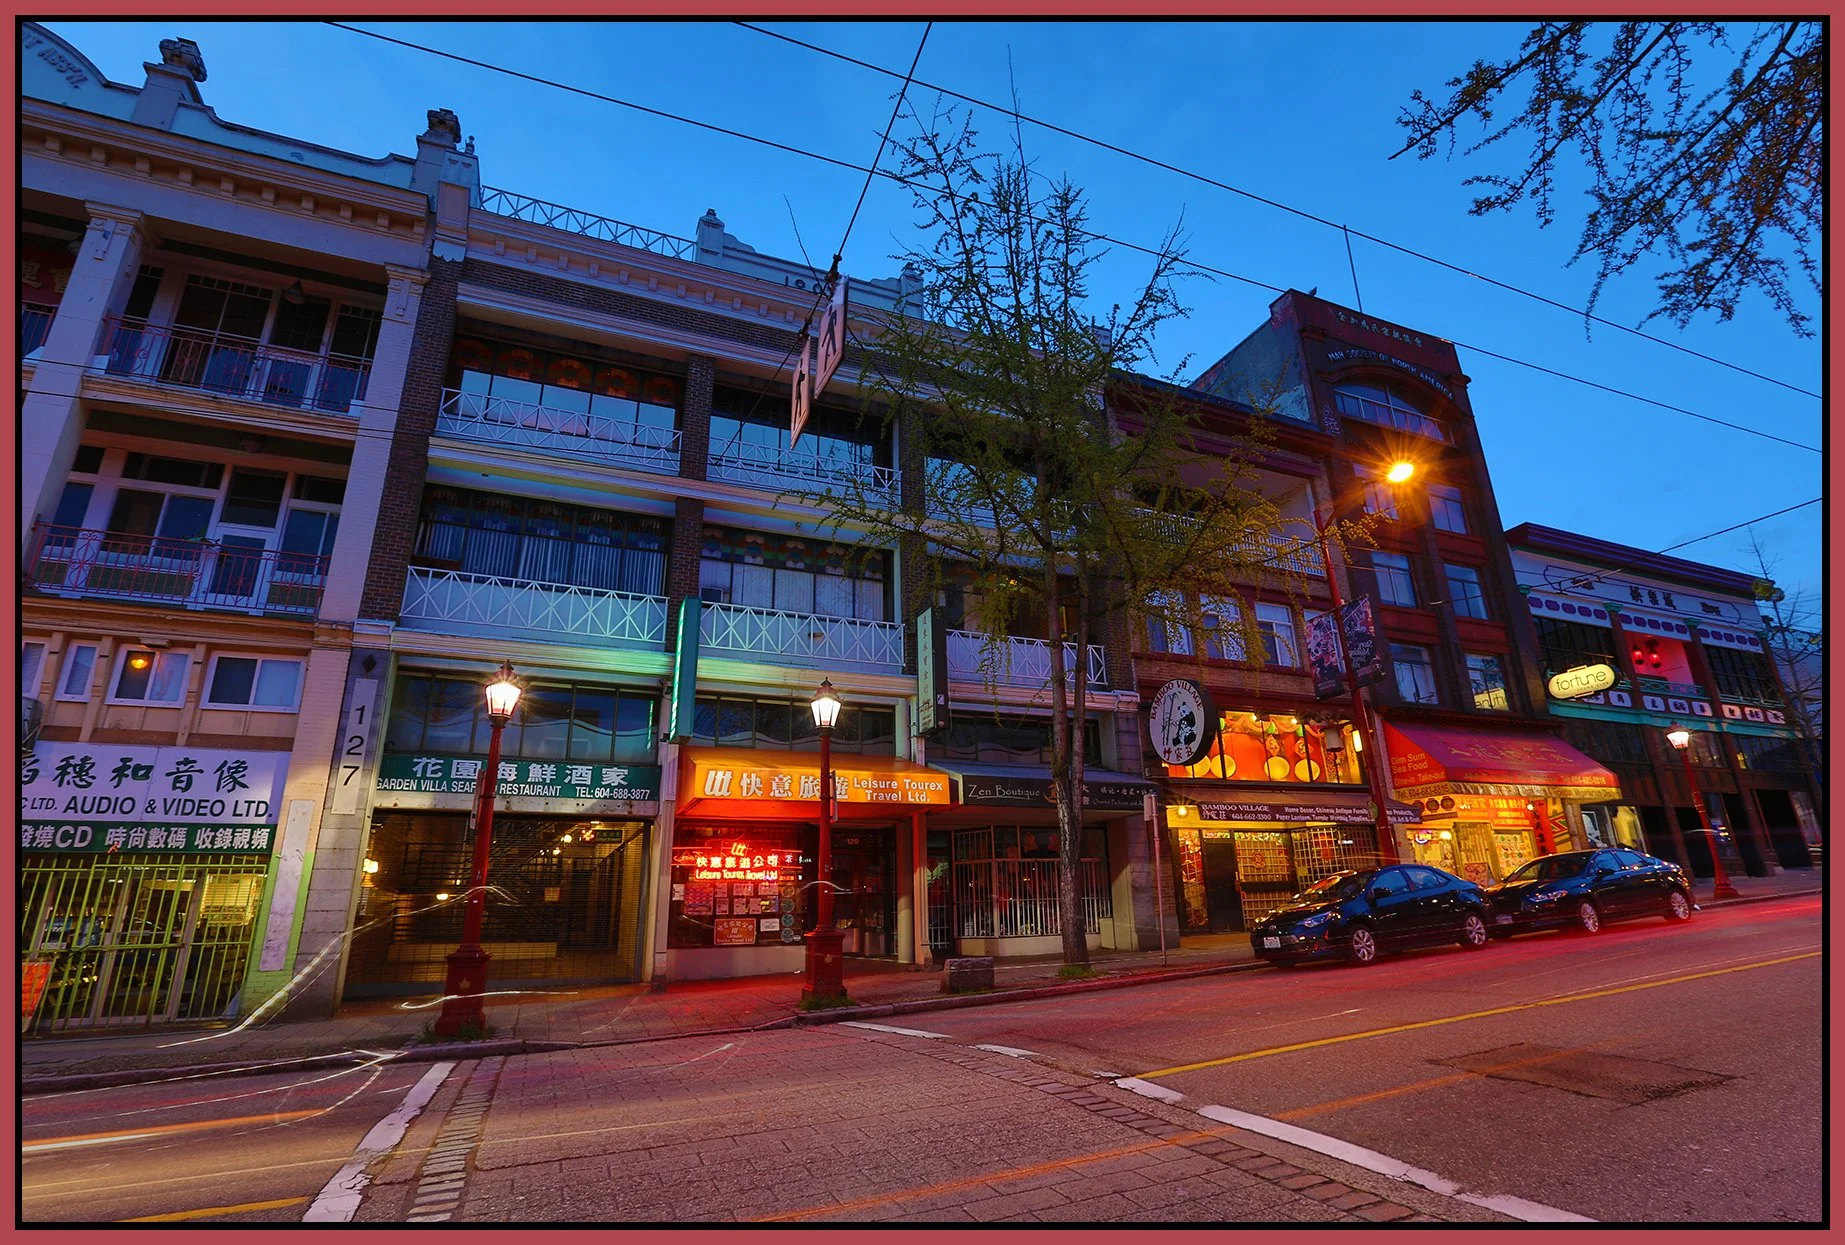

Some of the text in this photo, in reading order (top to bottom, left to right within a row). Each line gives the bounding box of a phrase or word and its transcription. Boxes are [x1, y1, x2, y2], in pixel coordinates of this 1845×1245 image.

[1328, 351, 1344, 361] MAH
[1391, 357, 1417, 374] NORTH
[1420, 371, 1454, 400] AMERICA
[1556, 671, 1606, 691] fortune
[1150, 681, 1203, 720] BAMBOO VILLAGE
[342, 704, 366, 786] 127
[1391, 752, 1426, 765] Dim Sum
[1392, 760, 1428, 774] Sea Food
[376, 778, 417, 790] GARDEN
[420, 779, 448, 792] VILLA
[499, 783, 562, 797] RESTAURANT
[853, 776, 943, 791] Leisure Tourex
[865, 790, 930, 802] Travel Ltd.
[968, 784, 1040, 800] Zen Boutique
[31, 797, 57, 810] LTD.
[63, 795, 136, 815] AUDIO
[144, 799, 156, 814] &
[162, 797, 225, 817] VIDEO
[232, 798, 273, 818] LTD.
[1201, 803, 1270, 812] BAMBOO VILLAGE
[695, 869, 778, 880] Leisure Tourex Travel Ltd
